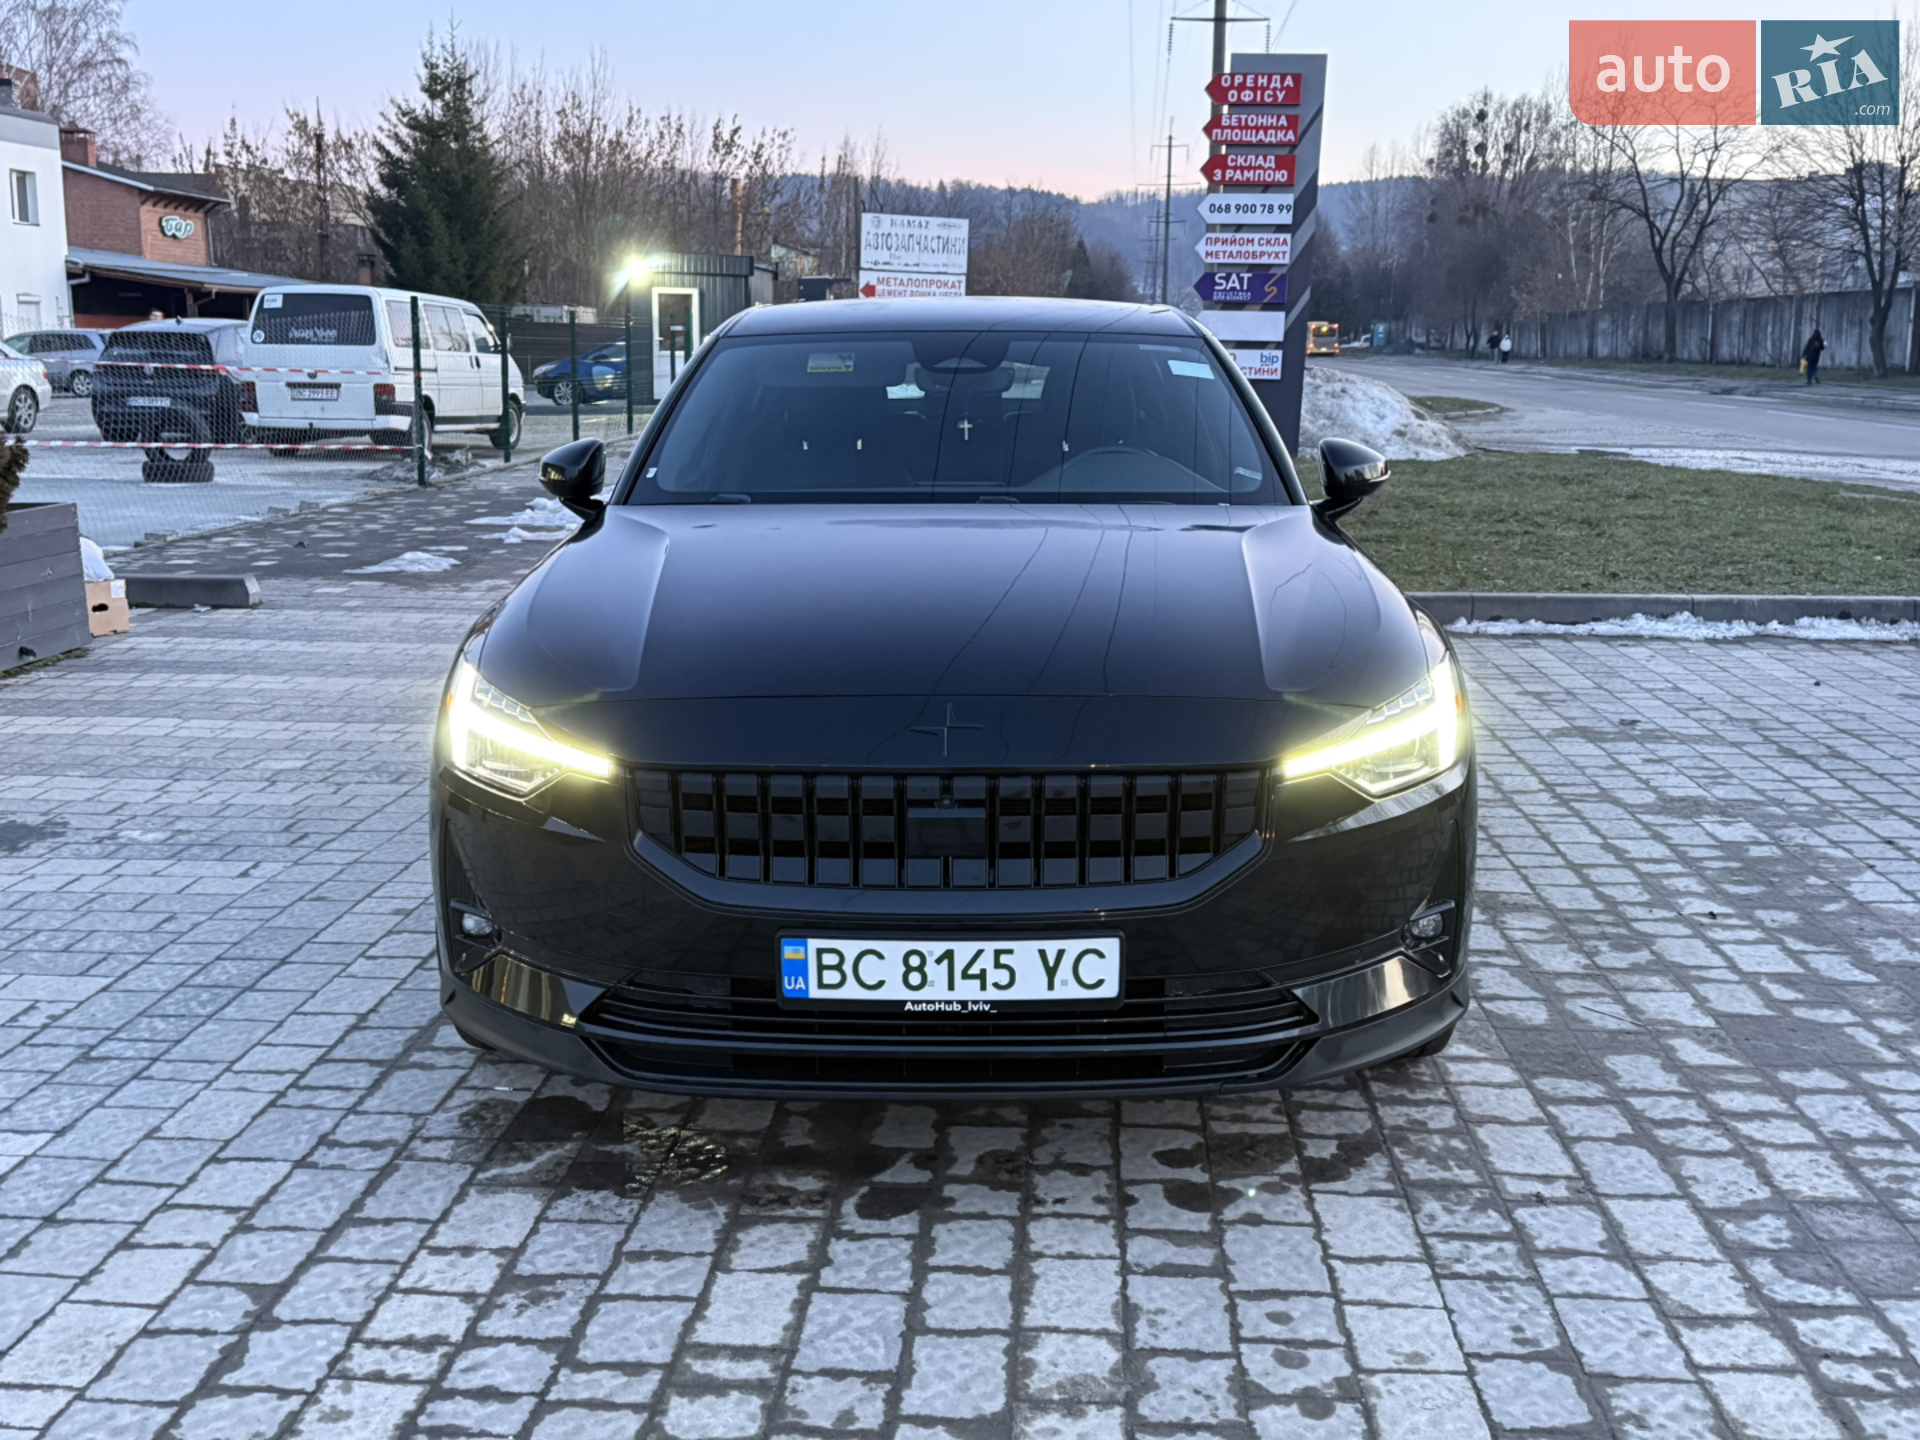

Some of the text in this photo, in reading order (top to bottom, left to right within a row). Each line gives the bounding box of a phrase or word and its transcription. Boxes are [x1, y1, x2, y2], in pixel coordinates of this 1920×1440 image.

[1221, 74, 1294, 89] ОРЕНДА
[1228, 90, 1286, 102] ОФІСУ
[1221, 114, 1288, 127] БЕТОННА
[1212, 129, 1295, 143] ПЛОЩАДКА
[1227, 154, 1276, 168] СКЛАД
[1213, 169, 1288, 182] З РАМПОЮ
[1209, 203, 1293, 214] 068 900 78 99
[864, 231, 965, 255] АВТОЗАПЧАСТИНИ
[1205, 235, 1289, 247] ПРИЙОМ СКЛА
[1205, 250, 1288, 260] МЕТАЛОБРУХТ
[877, 277, 963, 290] МЕТАЛОПРОКАТ
[1214, 273, 1252, 290] SAT
[1260, 352, 1279, 367] bip
[816, 947, 1106, 991] BC 8145 YC
[784, 976, 806, 990] UA
[904, 1001, 998, 1013] AutoHub_lviv_
